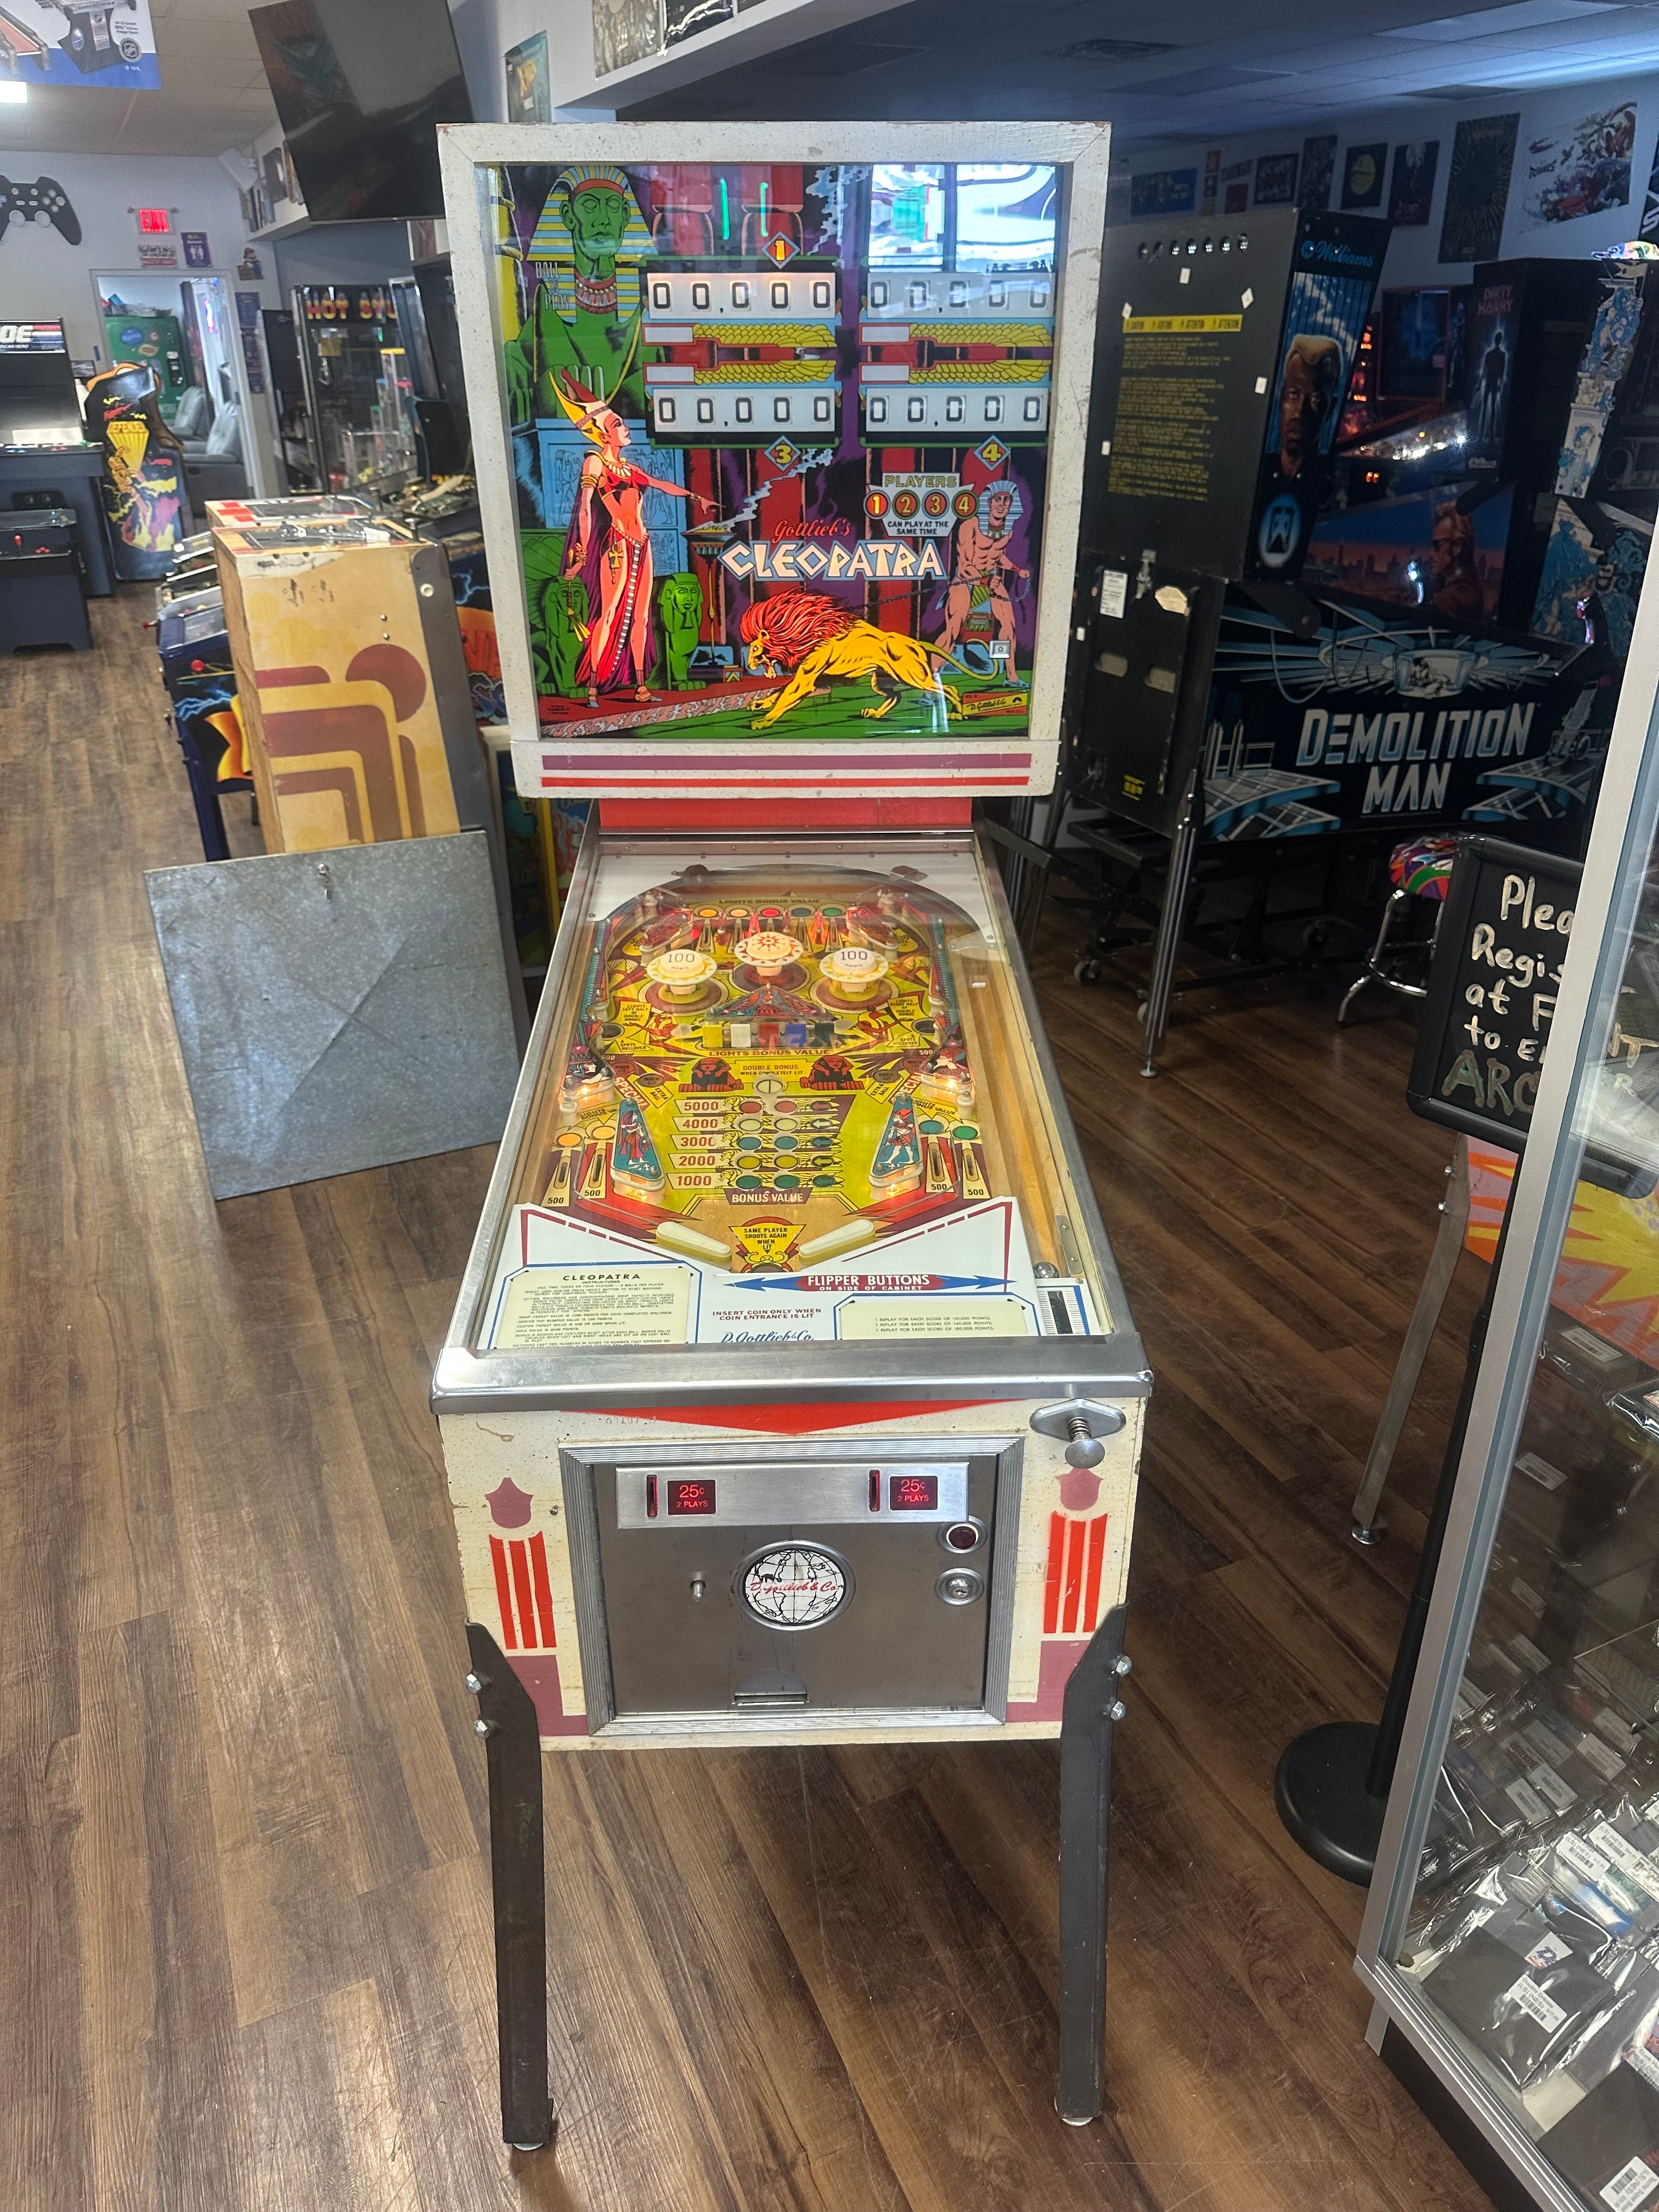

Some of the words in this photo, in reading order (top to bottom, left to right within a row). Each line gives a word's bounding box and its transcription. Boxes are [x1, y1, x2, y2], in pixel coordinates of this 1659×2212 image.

[774, 239, 786, 261] 1
[535, 262, 559, 279] BALL
[305, 292, 349, 320] HOT
[545, 294, 569, 311] PLAY
[0, 325, 33, 343] OE
[774, 444, 793, 464] 3
[983, 443, 1003, 463] 4
[884, 475, 957, 488] PLAYERS
[872, 495, 881, 514] 1
[900, 495, 912, 514] 2
[930, 495, 941, 514] 3
[958, 495, 970, 514] 4
[771, 518, 851, 544] Gottlieb's
[720, 541, 945, 580] CLEOPATRA
[1295, 702, 1535, 766] DEMOLITION
[1361, 762, 1452, 815] MAN
[668, 953, 695, 963] 100
[840, 951, 868, 961] 100
[1465, 978, 1510, 1015] at
[1463, 1014, 1501, 1050] to
[684, 1101, 719, 1111] 5000
[682, 1119, 719, 1128] 4000
[680, 1137, 714, 1147] 3000
[679, 1155, 715, 1166] 2000
[676, 1175, 712, 1186] 1000
[731, 1193, 769, 1203] BONUS
[771, 1193, 804, 1203] VALUE
[808, 1275, 859, 1286] FLIPPER
[867, 1274, 930, 1286] BUTTONS
[679, 1484, 705, 1498] 25¢
[900, 1479, 926, 1492] 25¢
[820, 1581, 840, 1592] Co.
